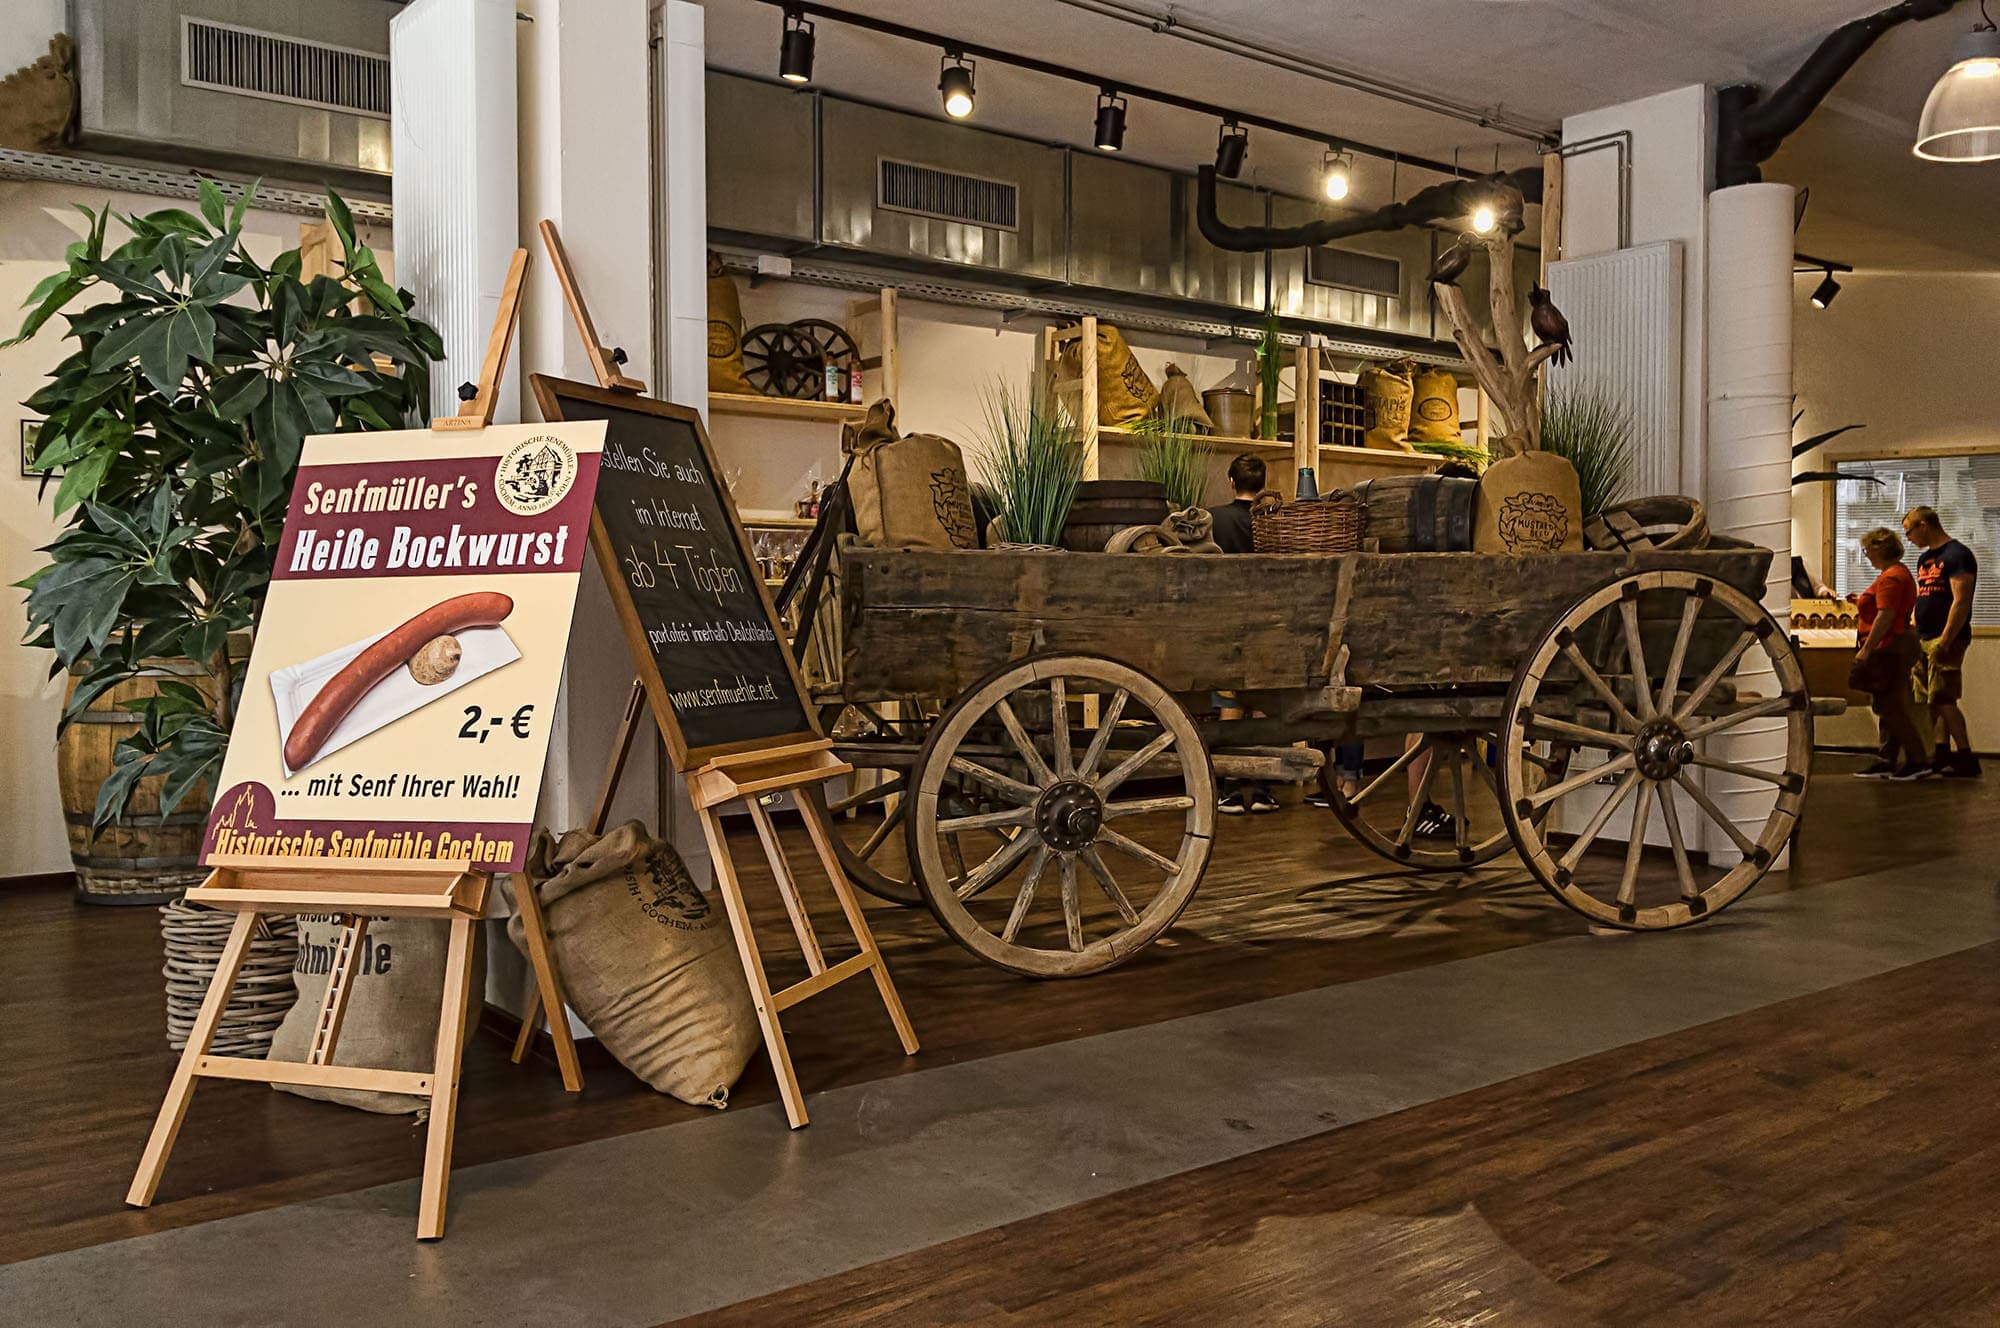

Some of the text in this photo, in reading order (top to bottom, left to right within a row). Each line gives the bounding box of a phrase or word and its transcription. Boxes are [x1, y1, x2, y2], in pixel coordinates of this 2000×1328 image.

[500, 435, 545, 473] HISTORISCHE
[600, 442, 705, 485] stellen Sie auch
[303, 475, 479, 515] Senfmüller's
[631, 497, 706, 531] im Internet
[289, 524, 569, 572] Heiße Bockwurst
[625, 540, 744, 607] ab 4 Töpfen
[648, 621, 691, 654] portofrei
[307, 773, 343, 798] mit
[348, 773, 398, 798] Senf
[401, 774, 456, 798] Ihrer
[462, 775, 520, 799] Wahl!
[214, 828, 514, 863] Historische Senfmühle Cochem
